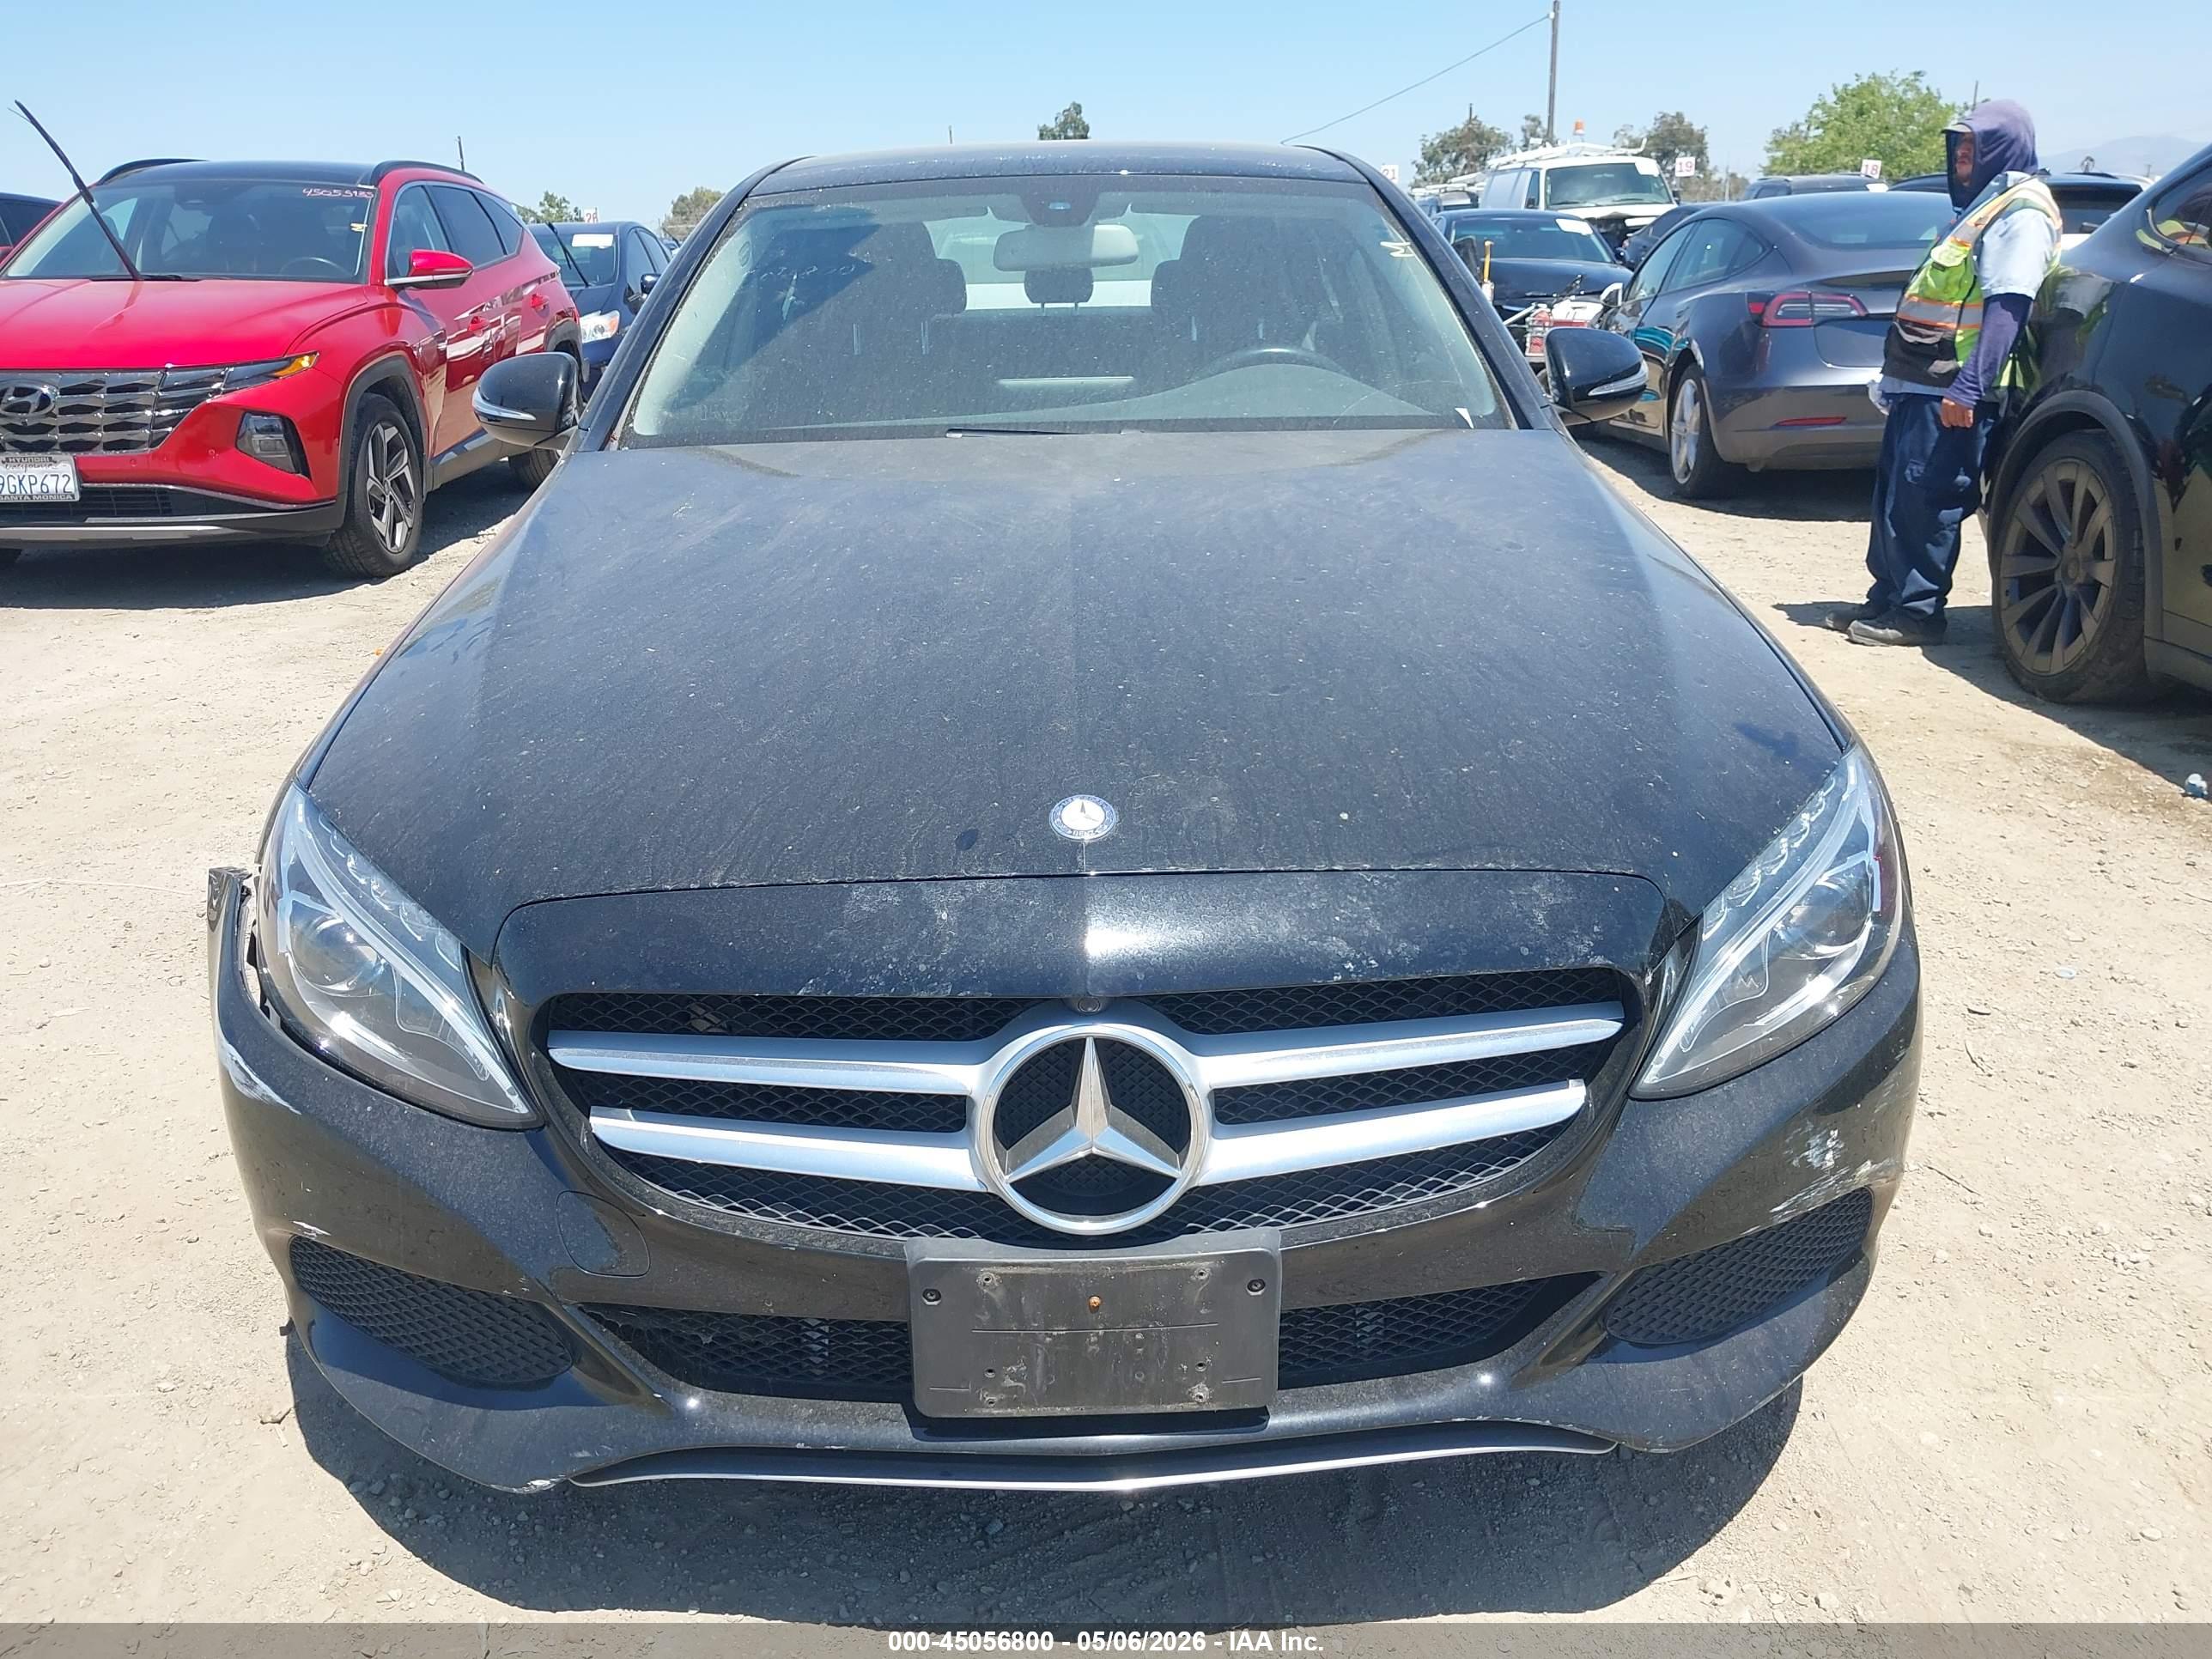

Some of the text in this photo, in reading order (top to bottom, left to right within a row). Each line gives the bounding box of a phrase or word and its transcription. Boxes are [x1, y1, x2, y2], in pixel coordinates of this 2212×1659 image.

[1676, 161, 1693, 173] 19
[1863, 164, 1879, 175] 18
[1382, 168, 1396, 179] 21
[0, 474, 73, 494] 9GKP672
